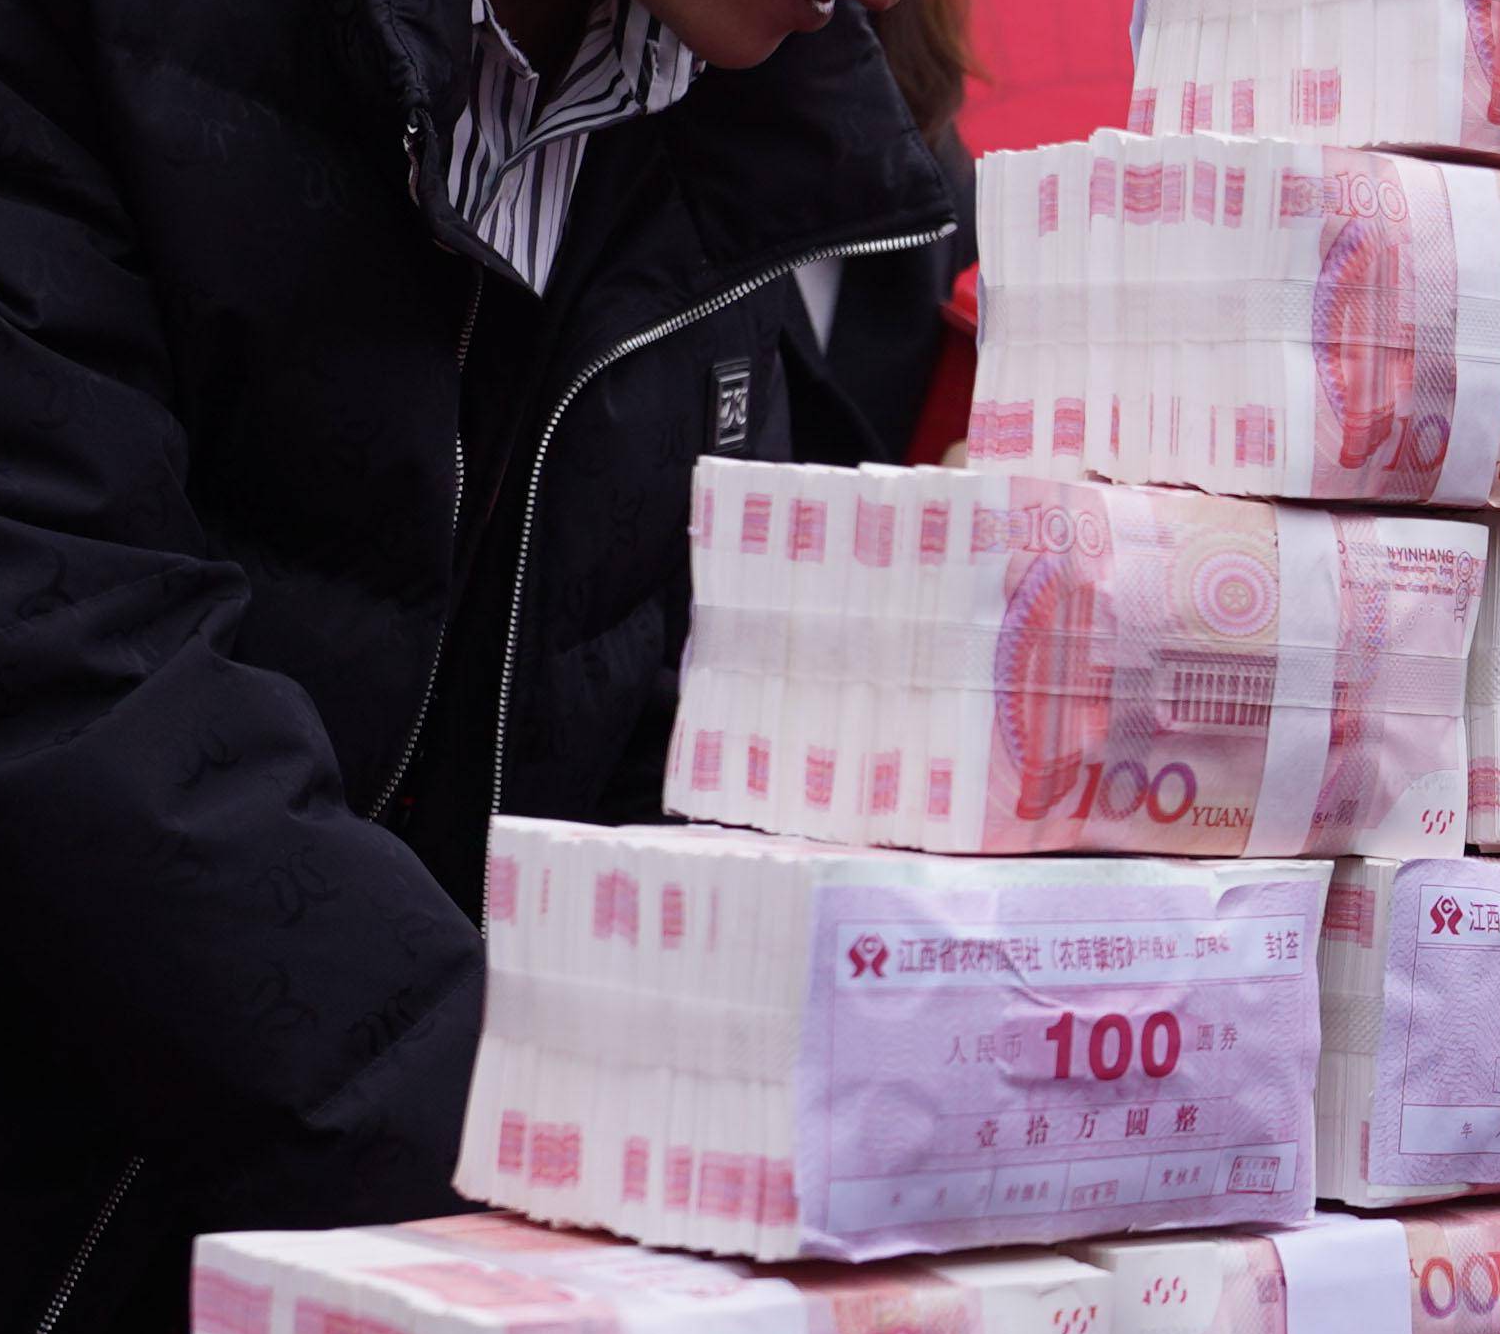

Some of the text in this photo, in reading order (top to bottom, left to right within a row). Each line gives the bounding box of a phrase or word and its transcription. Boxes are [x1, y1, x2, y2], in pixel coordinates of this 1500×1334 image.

[1336, 171, 1409, 222] 100
[1024, 505, 1105, 557] 100
[1070, 760, 1249, 828] 100 YUAN
[1264, 932, 1299, 962] 封签
[949, 1032, 1022, 1064] 人民币
[1046, 1011, 1182, 1080] 100
